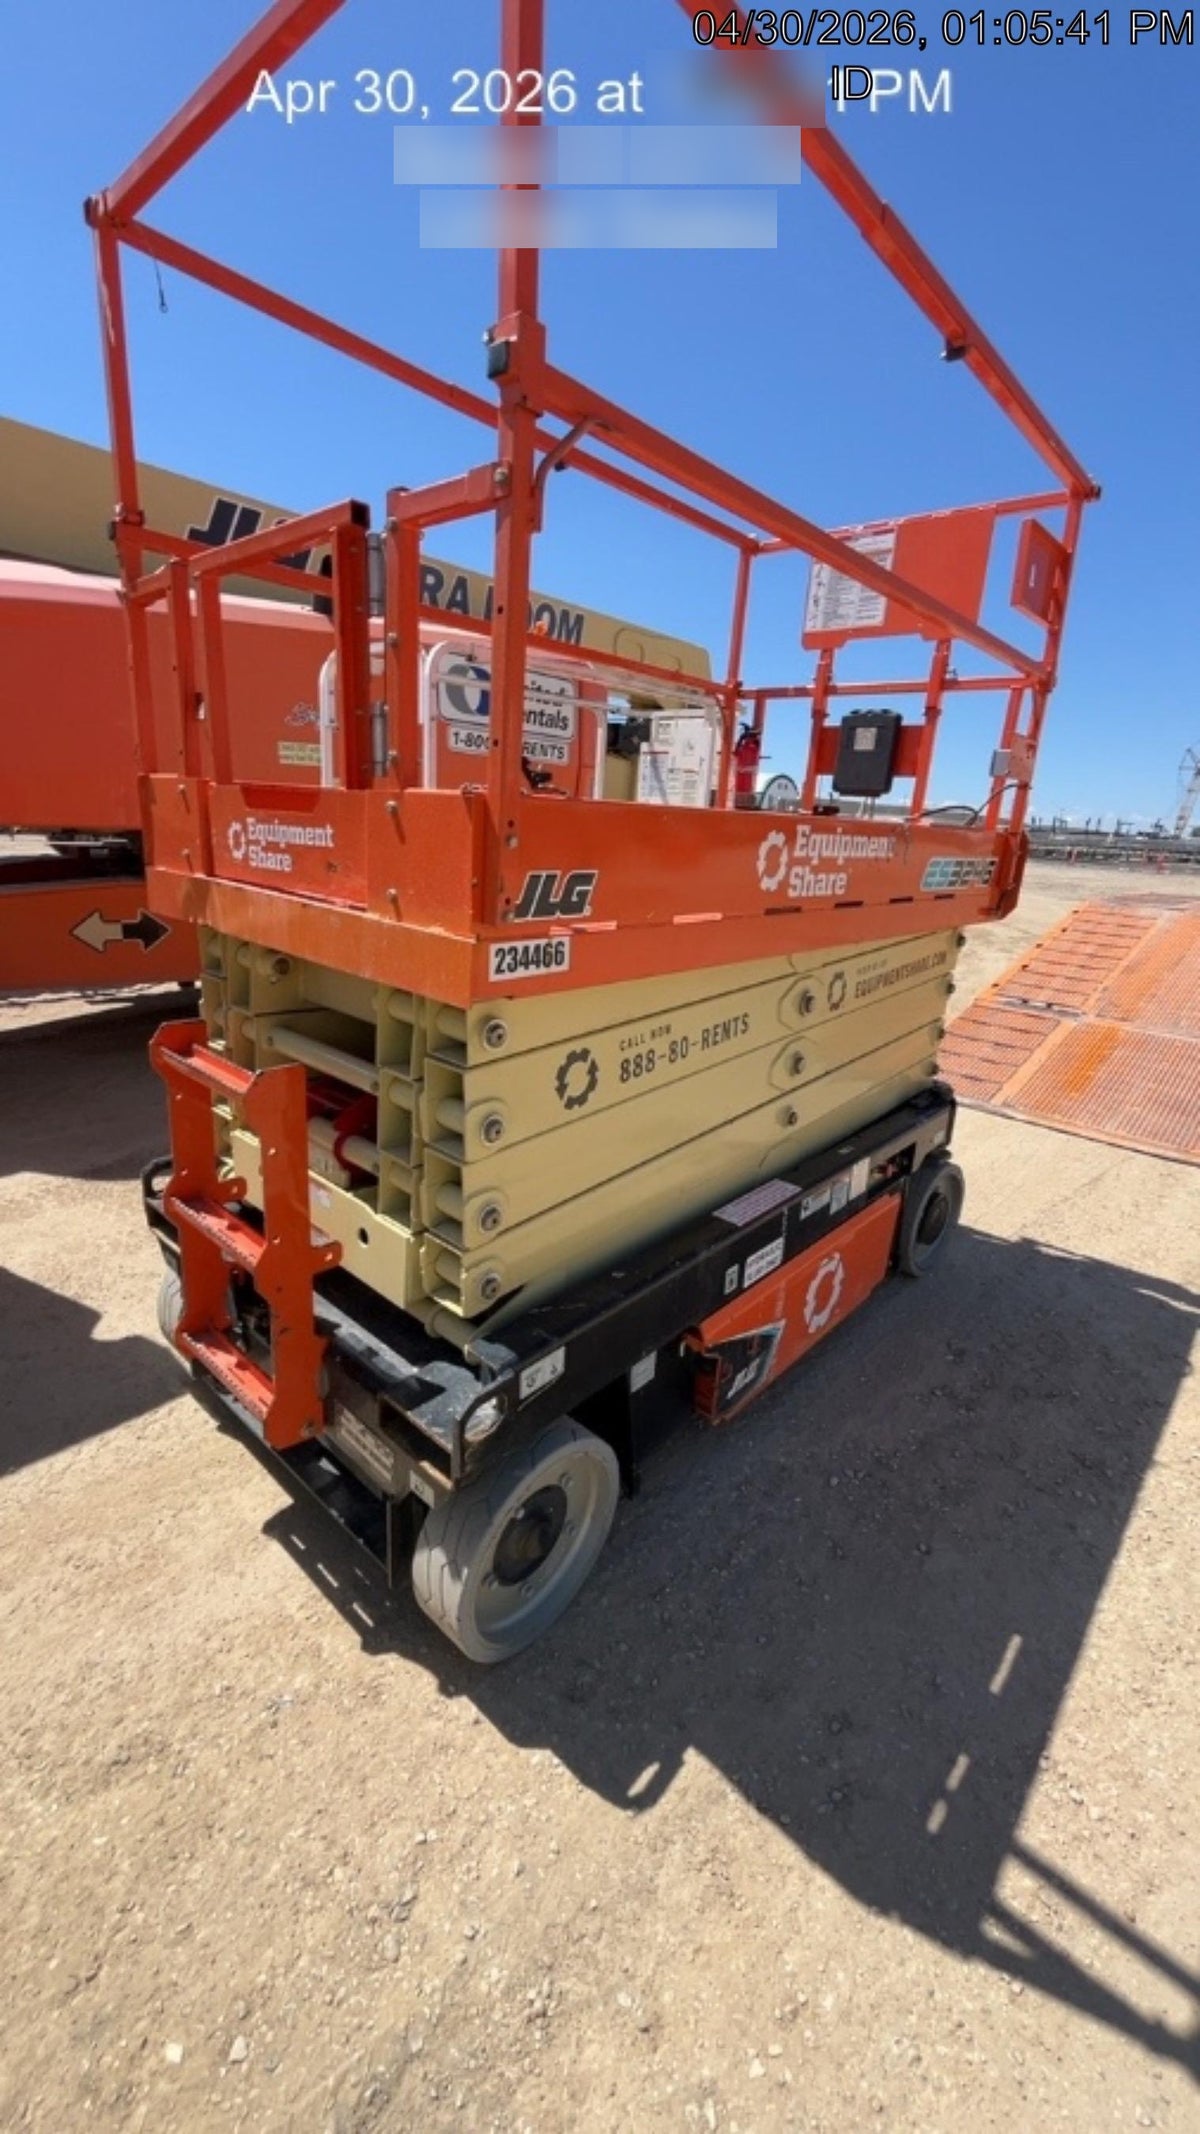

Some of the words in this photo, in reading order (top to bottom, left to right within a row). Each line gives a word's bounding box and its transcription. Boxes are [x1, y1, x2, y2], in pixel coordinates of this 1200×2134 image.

[246, 817, 334, 849] Equipment
[249, 845, 293, 872] Share
[513, 869, 599, 923] JLG
[788, 866, 847, 898] Share
[494, 941, 565, 975] 234466
[619, 1033, 646, 1052] CALL
[619, 1012, 750, 1084] 888-80-RENTS
